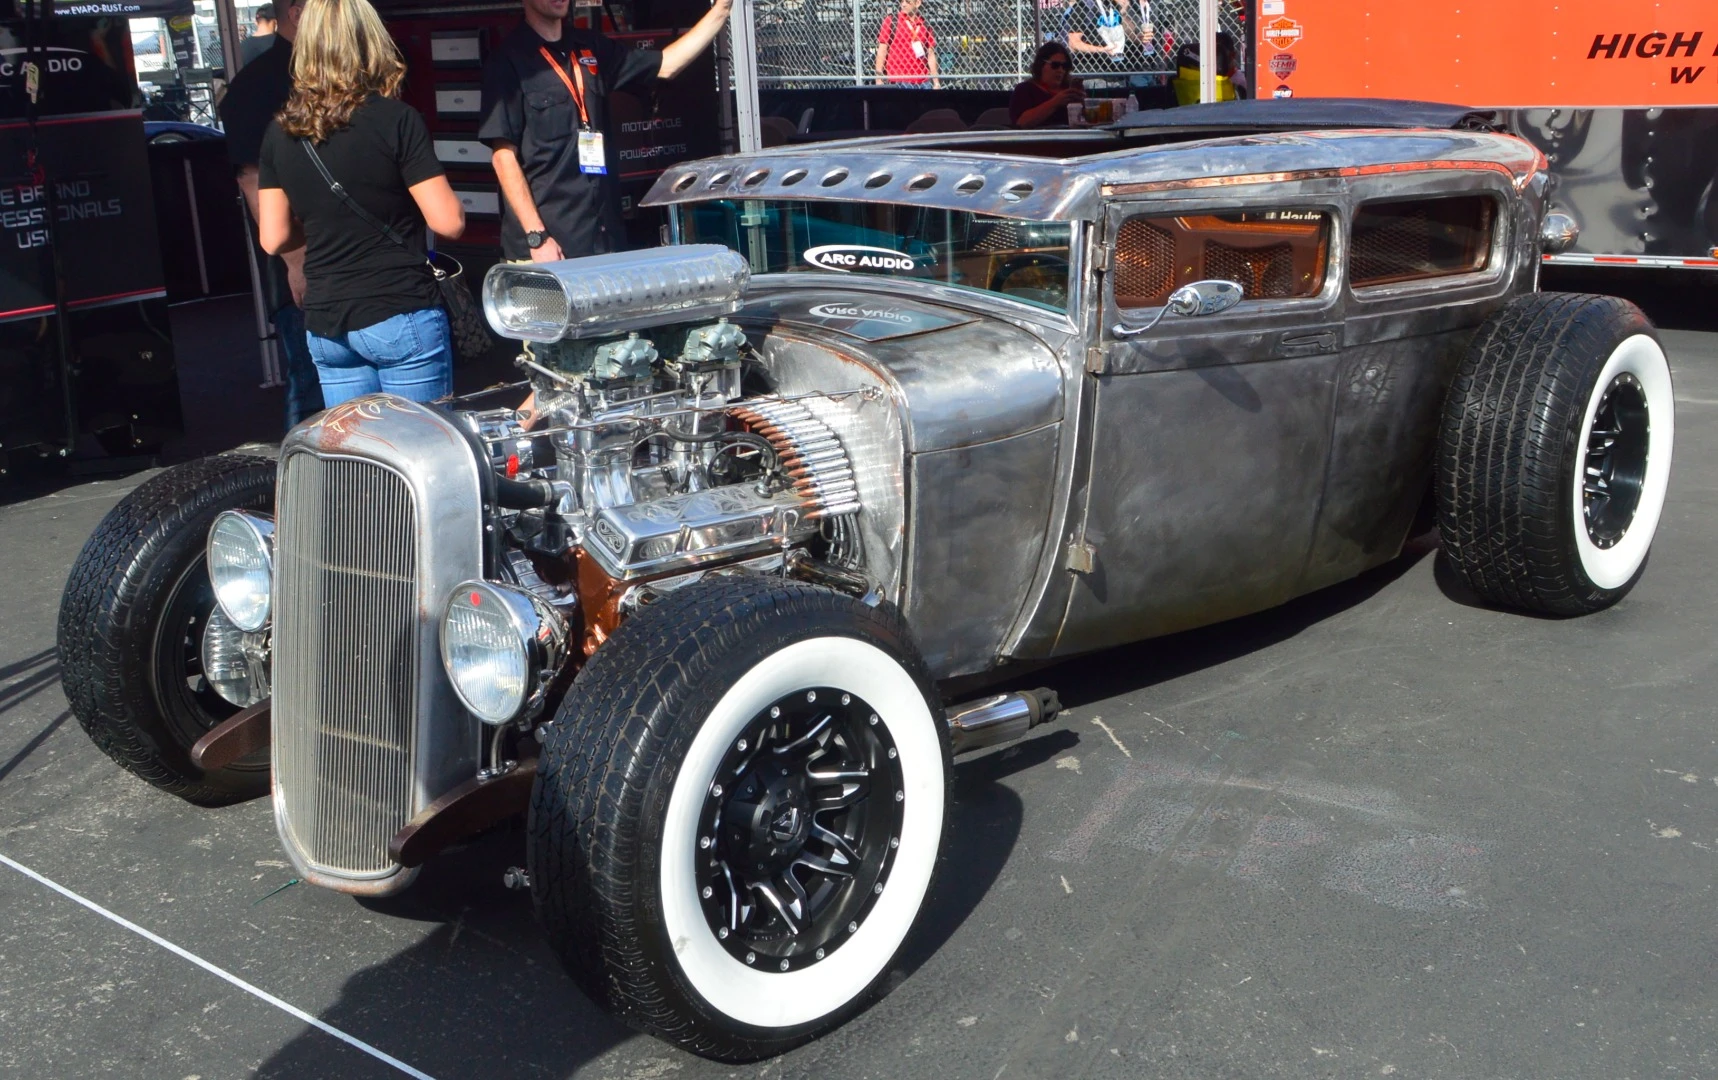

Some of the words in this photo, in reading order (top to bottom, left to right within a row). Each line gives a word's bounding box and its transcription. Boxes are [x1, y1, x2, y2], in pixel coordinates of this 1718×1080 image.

[1587, 31, 1704, 59] HIGH
[20, 58, 83, 76] ADIO
[621, 118, 682, 133] MOTORCYCLE
[619, 144, 686, 160] POWERSPORTS
[0, 198, 122, 229] ESSONALS
[821, 253, 857, 266] ARC
[859, 255, 915, 270] AUDIO
